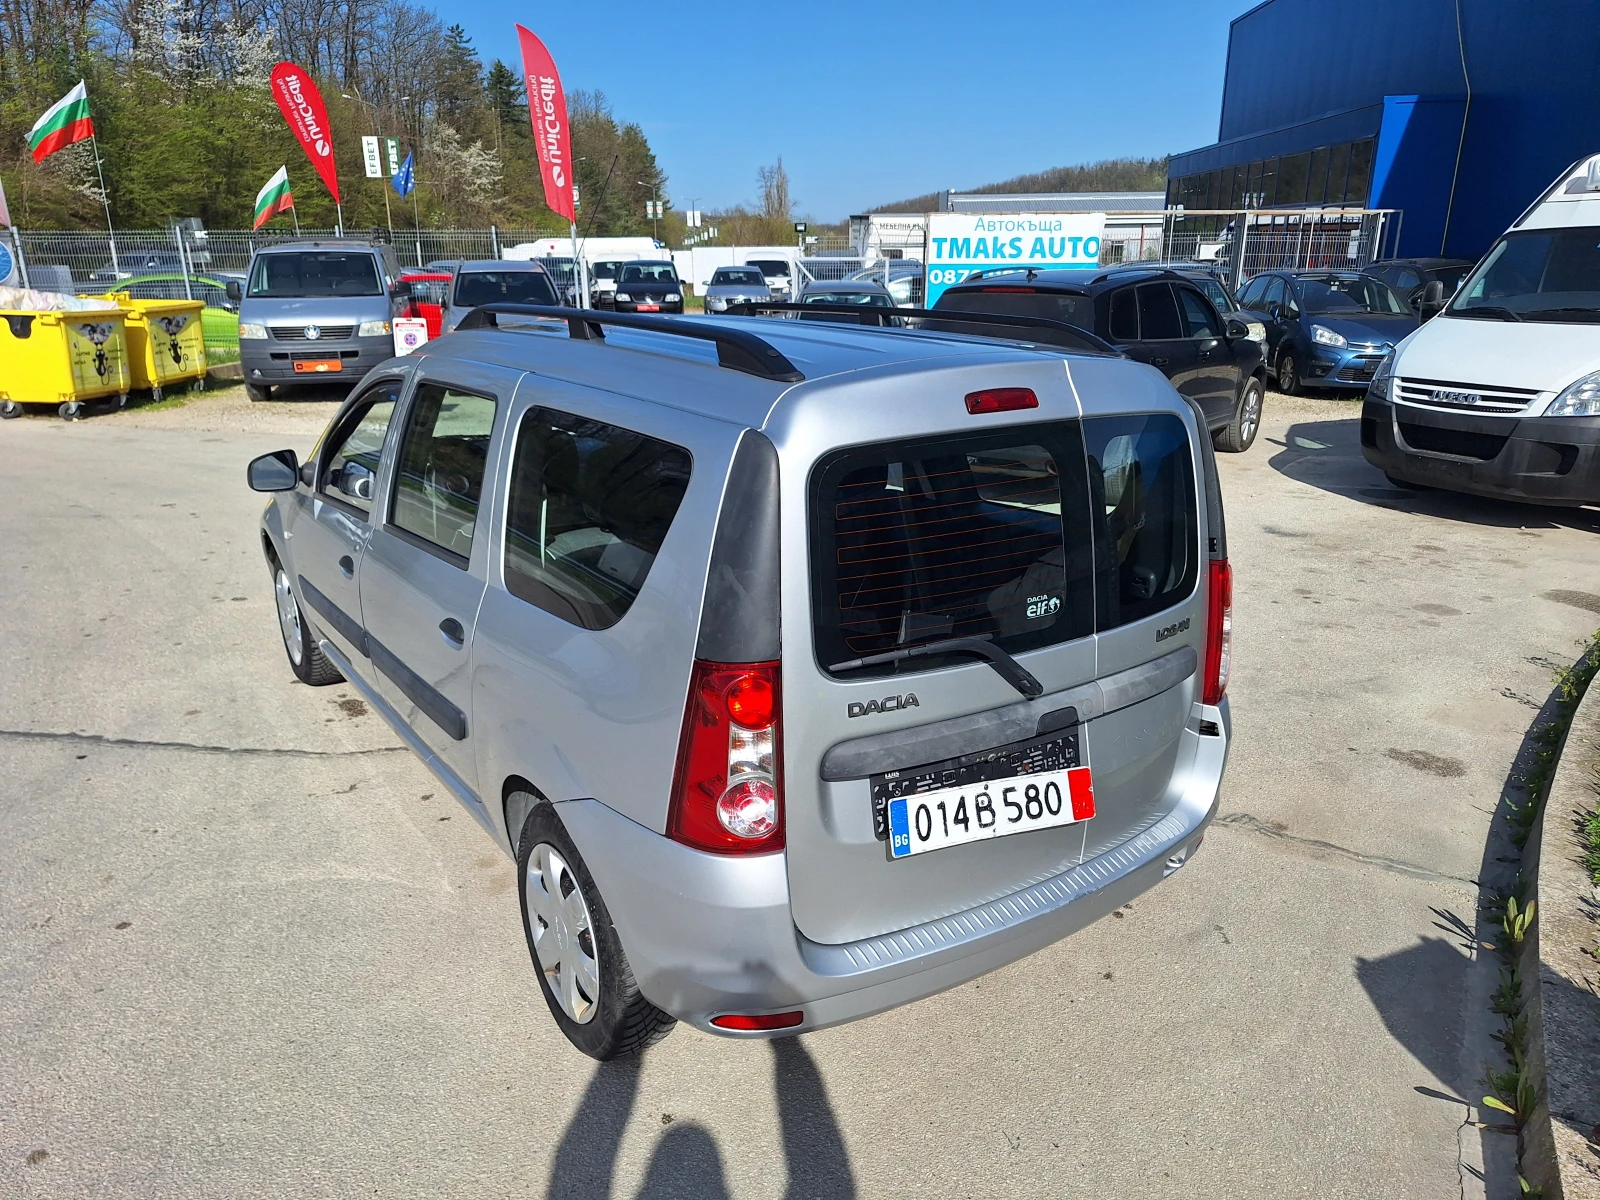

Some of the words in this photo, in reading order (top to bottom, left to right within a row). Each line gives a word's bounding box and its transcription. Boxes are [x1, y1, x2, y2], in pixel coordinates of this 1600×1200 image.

[367, 140, 378, 175] EFBET
[974, 217, 1063, 234] Автокъща
[932, 236, 1023, 259] TMAkS
[1029, 236, 1100, 259] AUTO
[929, 269, 981, 285] 087
[1428, 390, 1478, 405] IVECO
[1027, 594, 1048, 604] DACIA
[1026, 600, 1048, 617] elf
[1155, 617, 1190, 643] LOGAN
[848, 692, 919, 718] DACIA
[894, 834, 909, 848] BG
